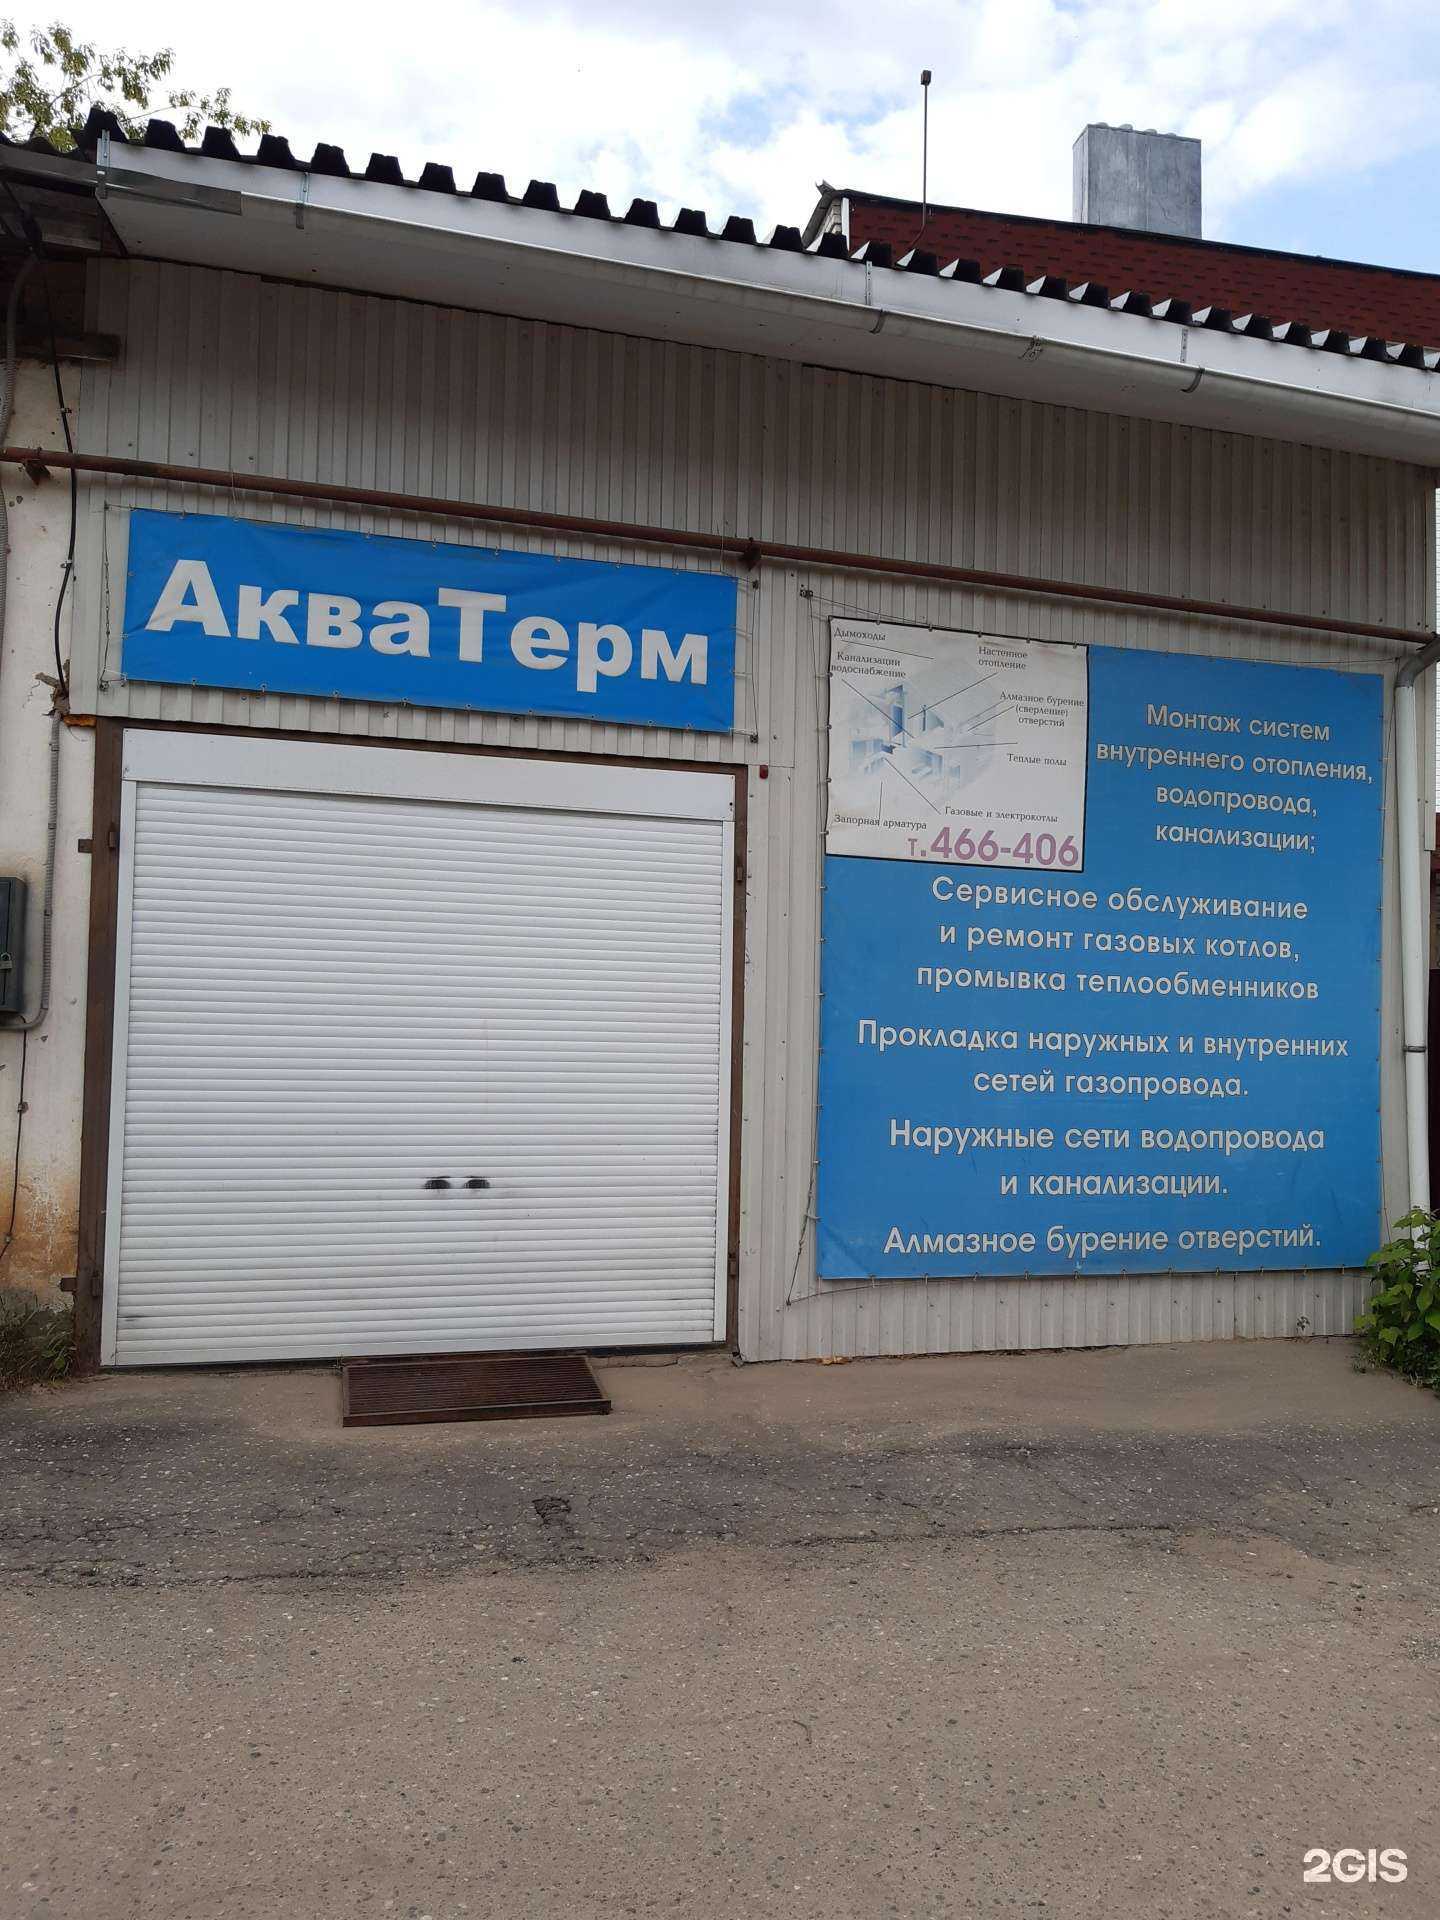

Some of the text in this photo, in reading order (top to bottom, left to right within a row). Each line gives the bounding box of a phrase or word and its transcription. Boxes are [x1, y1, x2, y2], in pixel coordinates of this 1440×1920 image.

[145, 559, 709, 693] АкваТерм
[833, 626, 886, 641] Дымоходы
[977, 646, 1028, 658] Настенное
[977, 659, 1027, 669] отопление
[830, 664, 906, 678] водоснабжение
[999, 691, 1085, 706] Алмазное бурение
[1015, 703, 1068, 717] (сверление)
[1018, 716, 1065, 727] отверстий
[1146, 704, 1330, 741] Монтаж систем
[1006, 752, 1067, 766] Теплые полы
[1096, 743, 1374, 784] внутреннего отопления,
[944, 806, 1058, 823] Газовые и электрокотлы
[1156, 786, 1317, 817] водопровода,
[833, 814, 927, 830] Запорная арматура
[1156, 824, 1316, 853] канализации;
[932, 876, 1309, 922] Сервисное обслуживание
[939, 924, 1300, 962] и ремонт газовых котлов,
[917, 965, 1319, 1000] промывка теплообменников
[858, 1019, 1349, 1062] Прокладка наружных и внутренних
[973, 1070, 1249, 1101] сетей газопровода.
[889, 1119, 1325, 1156] Наружные сети водопровода
[1000, 1172, 1229, 1198] и канализации.
[884, 1223, 1322, 1259] Алмазное бурение отверстий.
